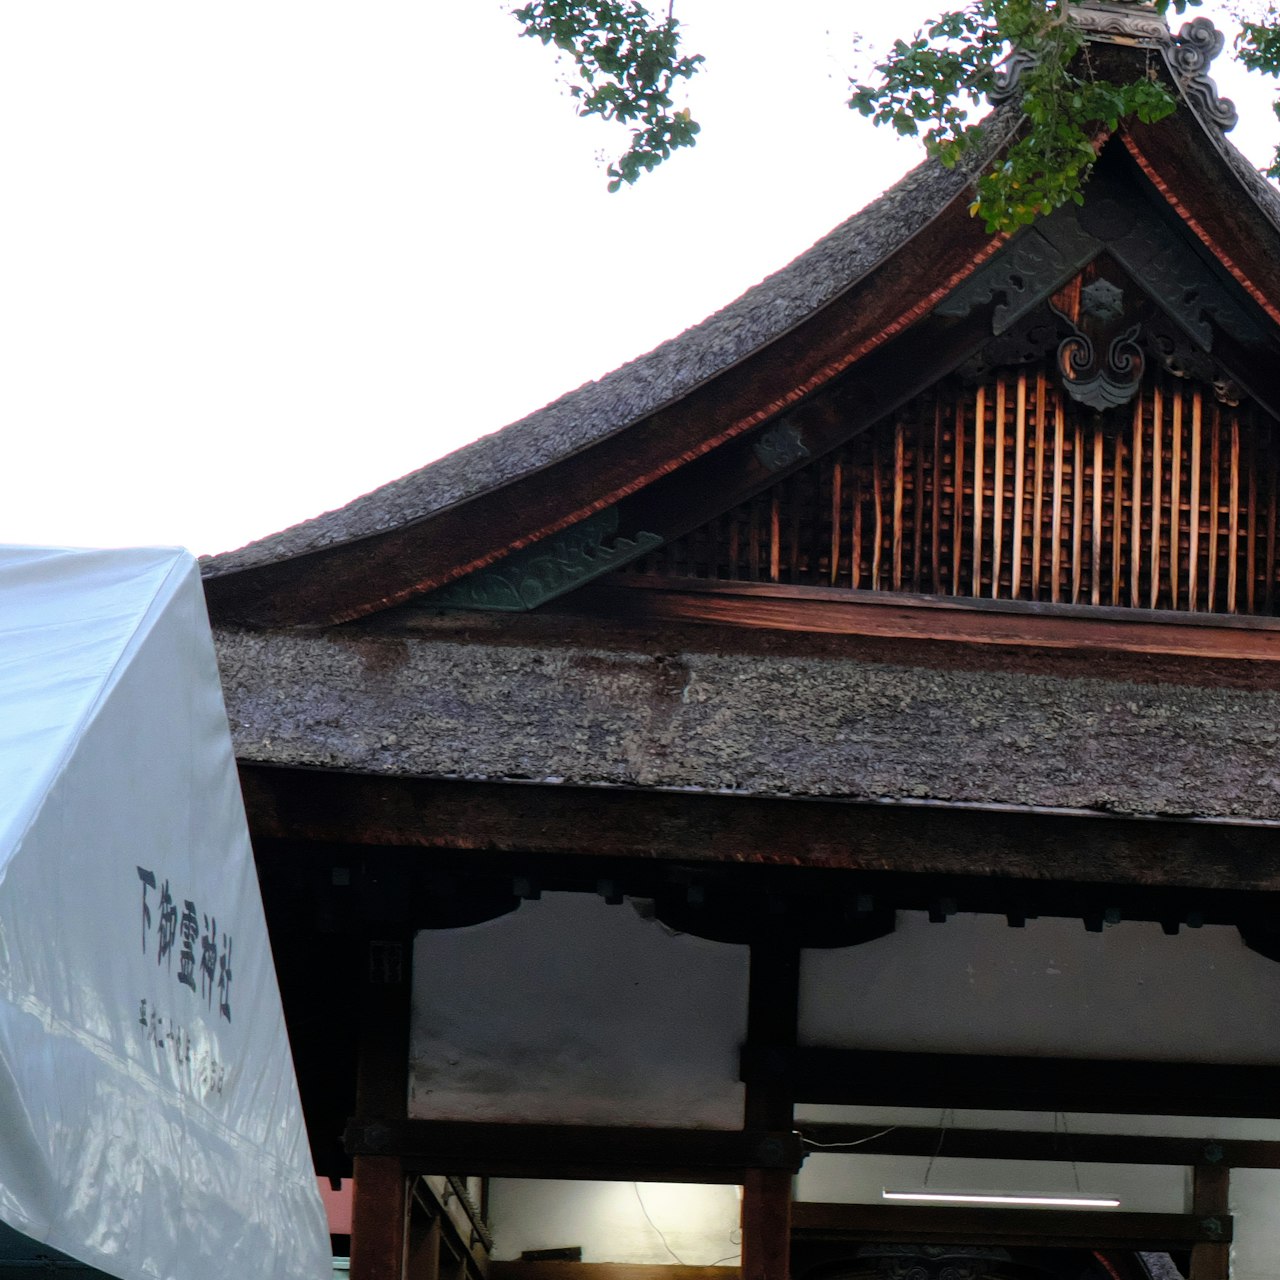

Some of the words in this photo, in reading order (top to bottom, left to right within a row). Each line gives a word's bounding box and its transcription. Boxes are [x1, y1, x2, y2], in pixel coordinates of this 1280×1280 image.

[137, 865, 232, 1024] 下御霊神社
